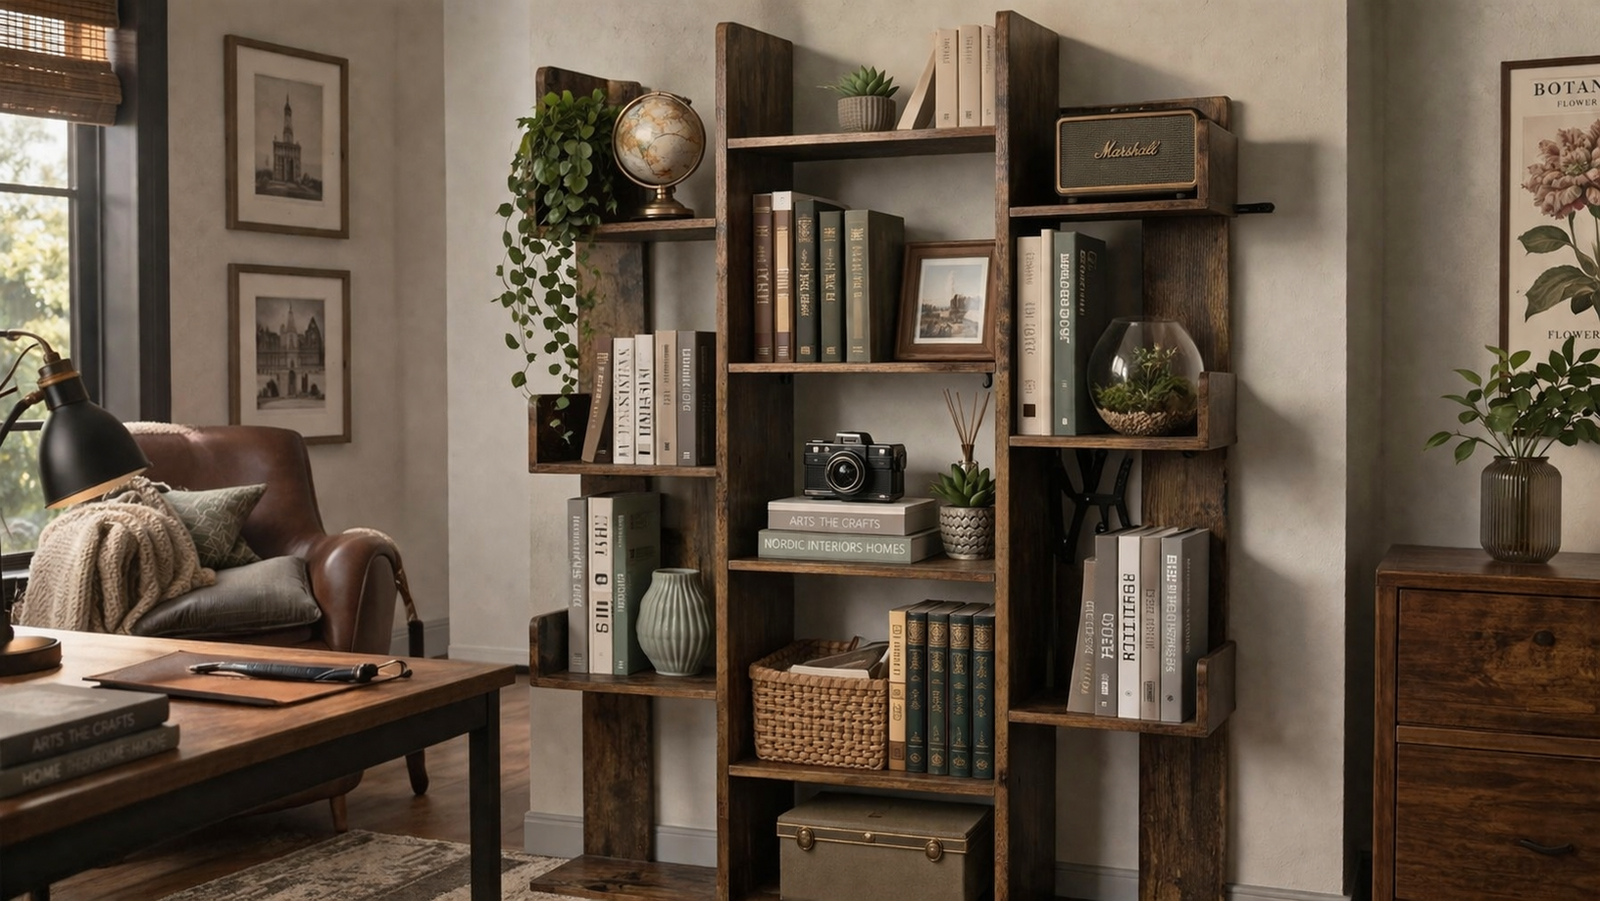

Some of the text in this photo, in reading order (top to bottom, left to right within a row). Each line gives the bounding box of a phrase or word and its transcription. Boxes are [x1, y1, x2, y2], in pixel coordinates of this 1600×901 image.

[1557, 98, 1598, 108] FLOWER
[1094, 140, 1161, 159] Marshall
[1547, 329, 1600, 340] FLOWER
[789, 515, 881, 529] ARTS THE CRAFTS
[764, 538, 906, 555] NORDIC INTERIORS HOMES
[31, 712, 135, 753] ARTS THE CRAFTS
[22, 762, 62, 786] HOME
